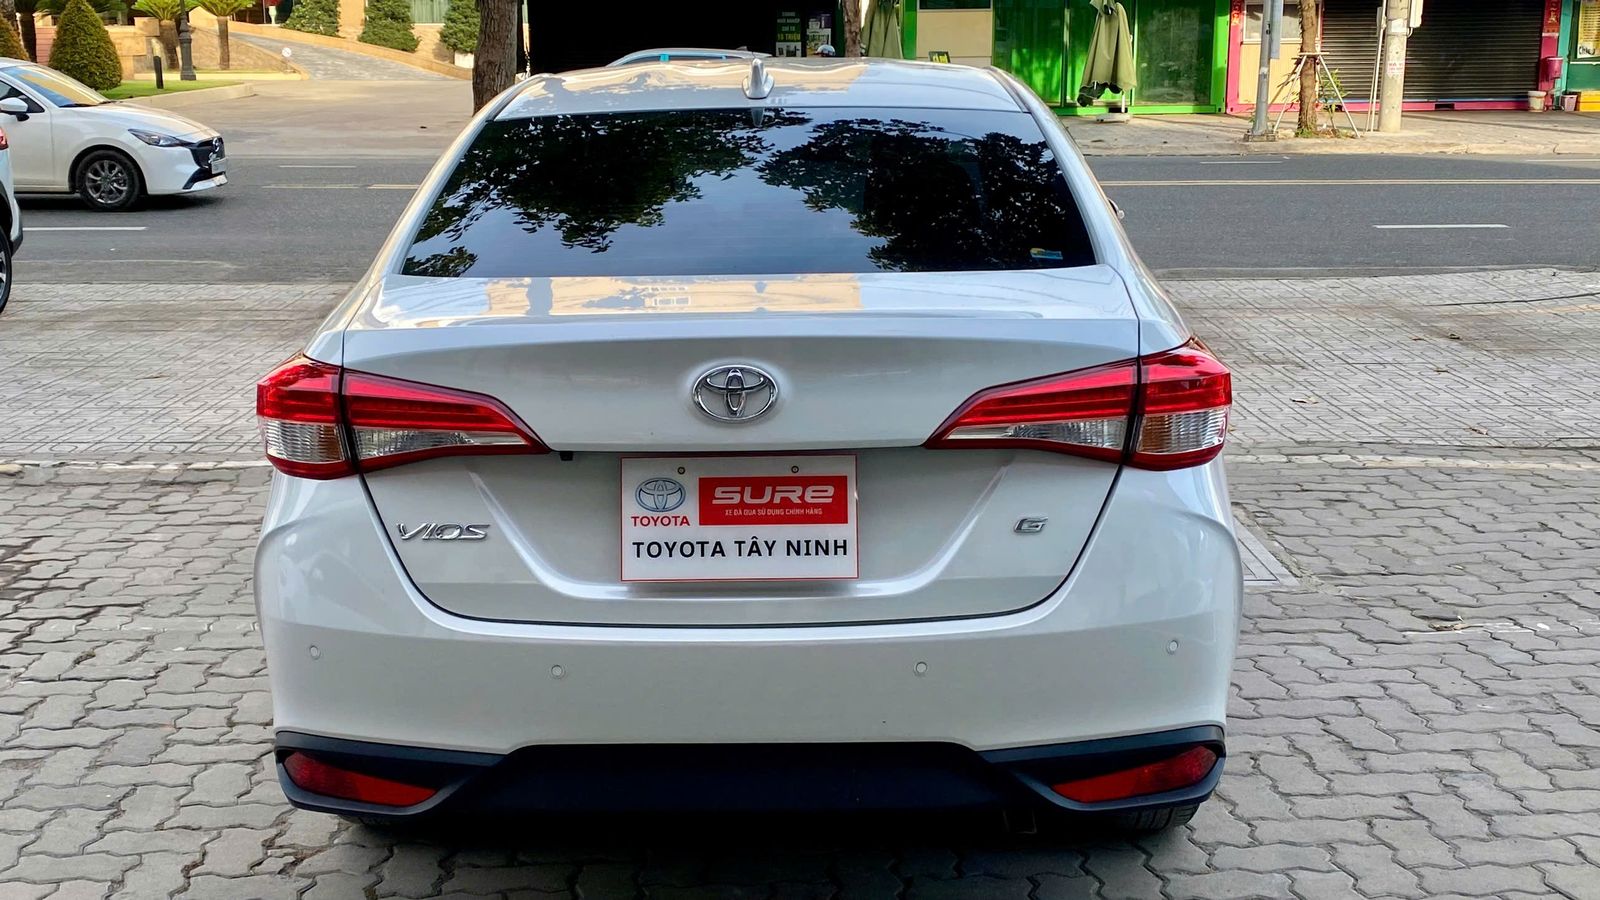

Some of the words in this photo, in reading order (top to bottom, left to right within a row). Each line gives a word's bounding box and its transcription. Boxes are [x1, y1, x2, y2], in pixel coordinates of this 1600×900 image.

[631, 515, 690, 527] TOYOTA
[1014, 517, 1048, 534] G
[397, 523, 490, 540] VIOS
[632, 540, 726, 558] TOYOTA
[734, 536, 777, 557] TÂY
[786, 539, 847, 556] NINH
